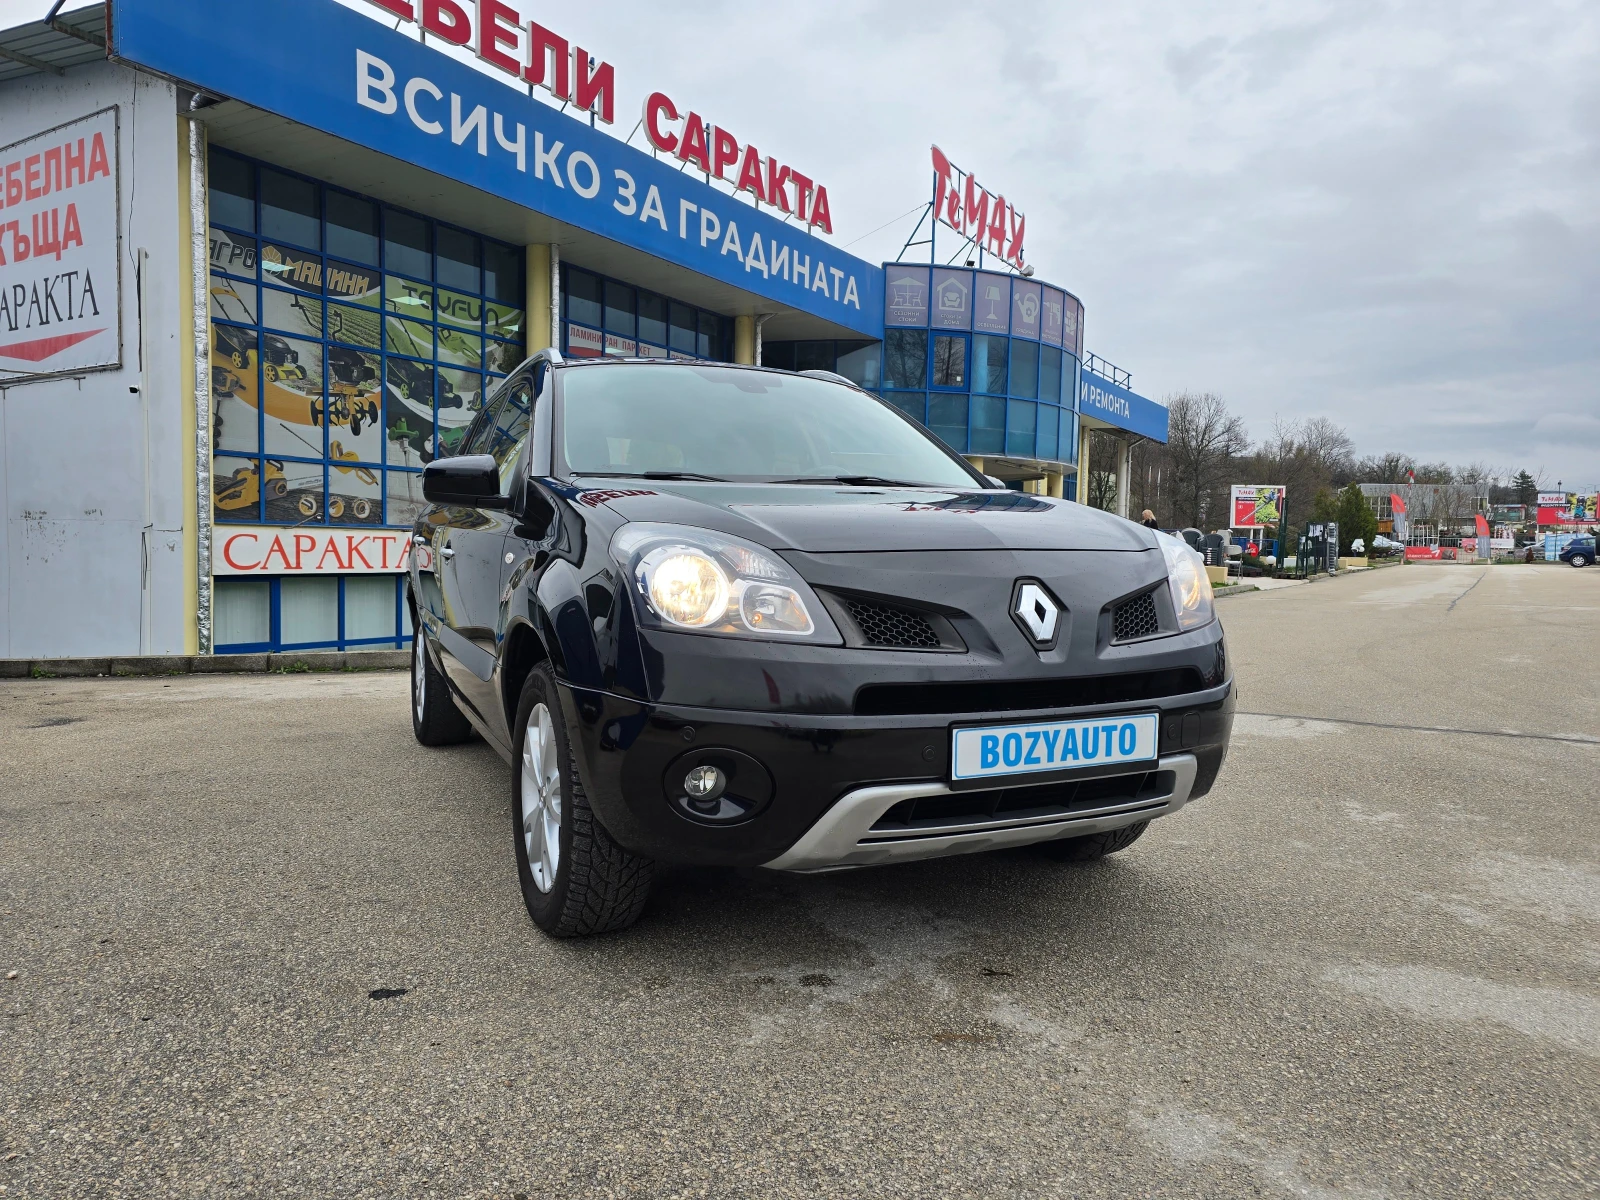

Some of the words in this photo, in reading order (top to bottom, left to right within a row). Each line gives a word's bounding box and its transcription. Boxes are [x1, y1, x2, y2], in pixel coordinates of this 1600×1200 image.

[0, 131, 111, 210] БЕЛНА
[356, 48, 601, 199] ВСИЧКО
[613, 169, 668, 232] ЗА
[679, 198, 861, 310] ГРАДИНАТА
[642, 91, 833, 235] САРАКТА
[931, 144, 1025, 270] TeMAX
[1089, 385, 1130, 419] РЕМОНТА
[980, 722, 1137, 770] BOZYAUTO
